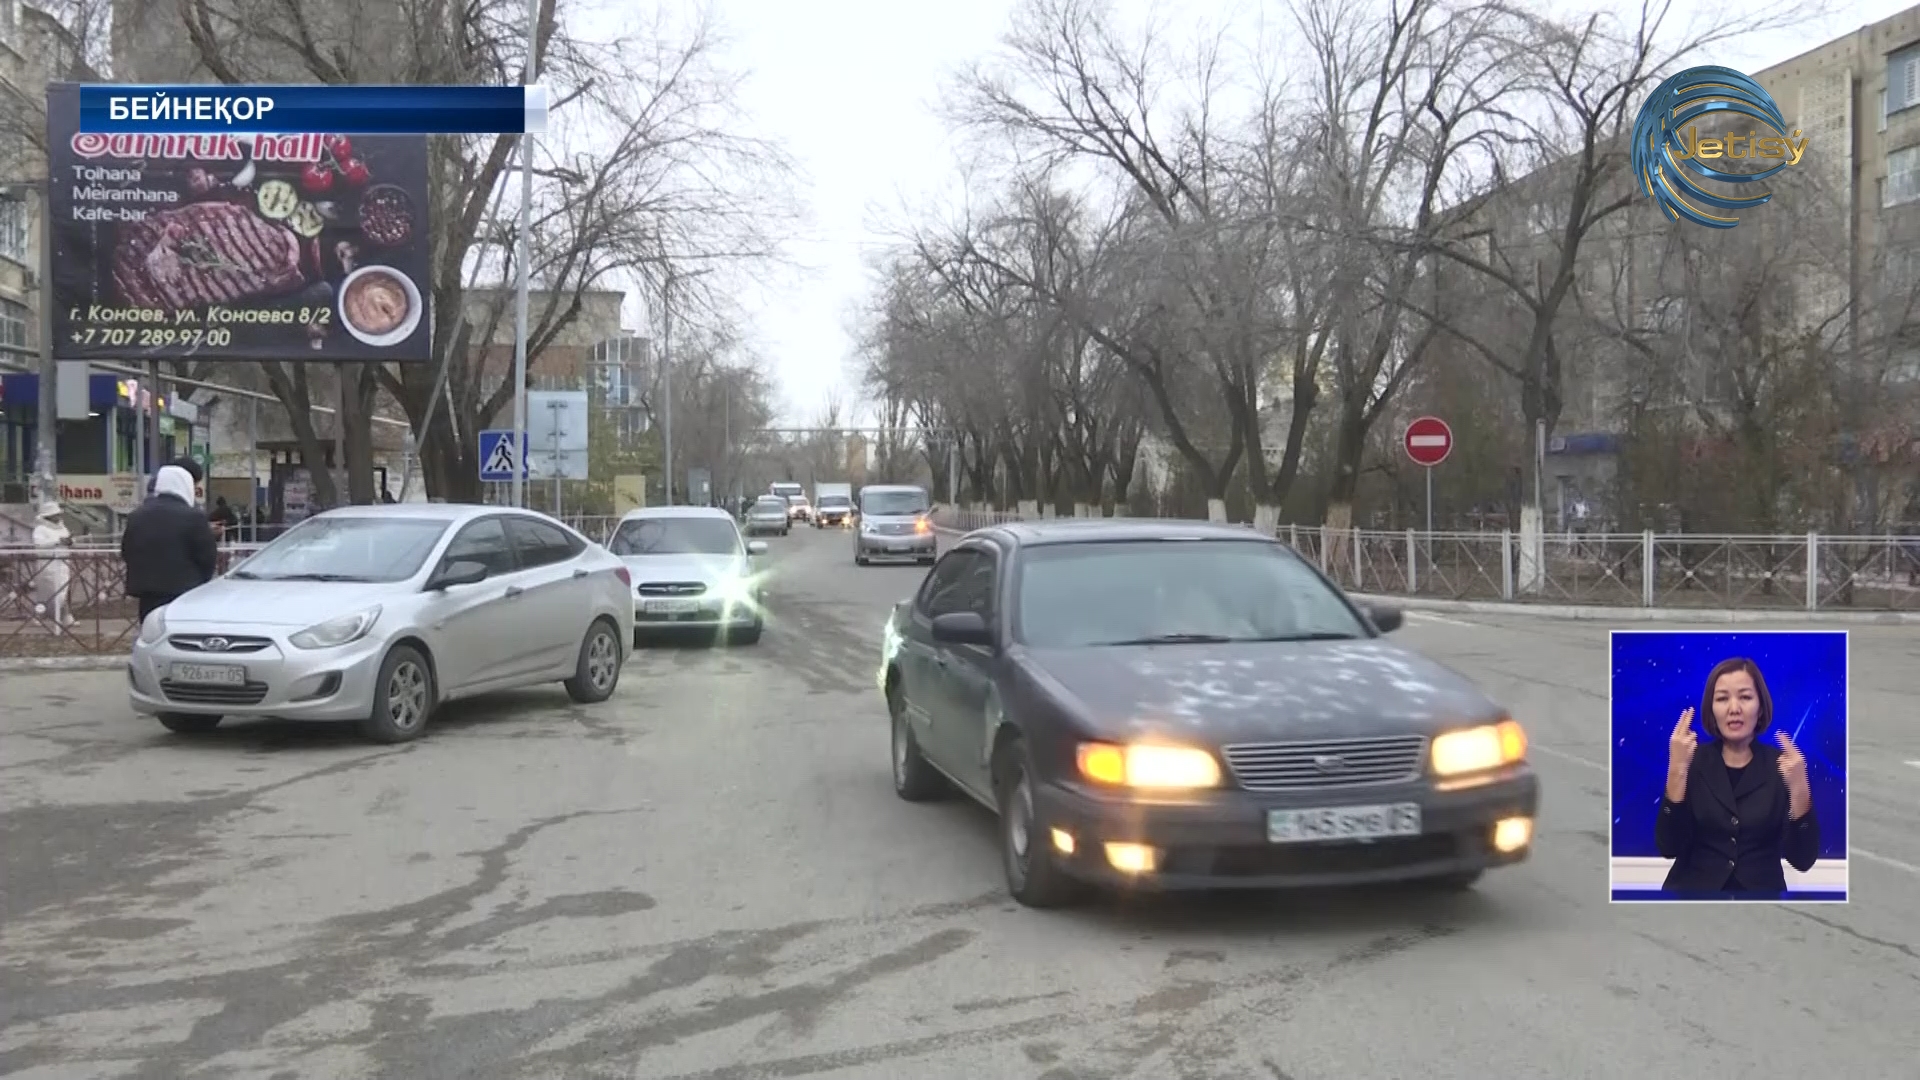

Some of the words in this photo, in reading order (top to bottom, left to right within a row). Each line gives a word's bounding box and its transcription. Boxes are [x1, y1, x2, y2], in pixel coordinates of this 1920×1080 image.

[72, 165, 142, 181] Toihana
[73, 186, 178, 203] Meiramhana
[73, 207, 148, 222] Kafe-bar
[69, 308, 82, 321] г.
[88, 306, 168, 324] Конаев,
[175, 308, 201, 325] ул.
[207, 306, 293, 323] Конаева
[298, 307, 331, 324] 8/2
[71, 329, 95, 345] +7
[100, 329, 136, 345] 707
[139, 329, 176, 346] 289
[180, 330, 204, 346] 97
[206, 330, 231, 346] 00
